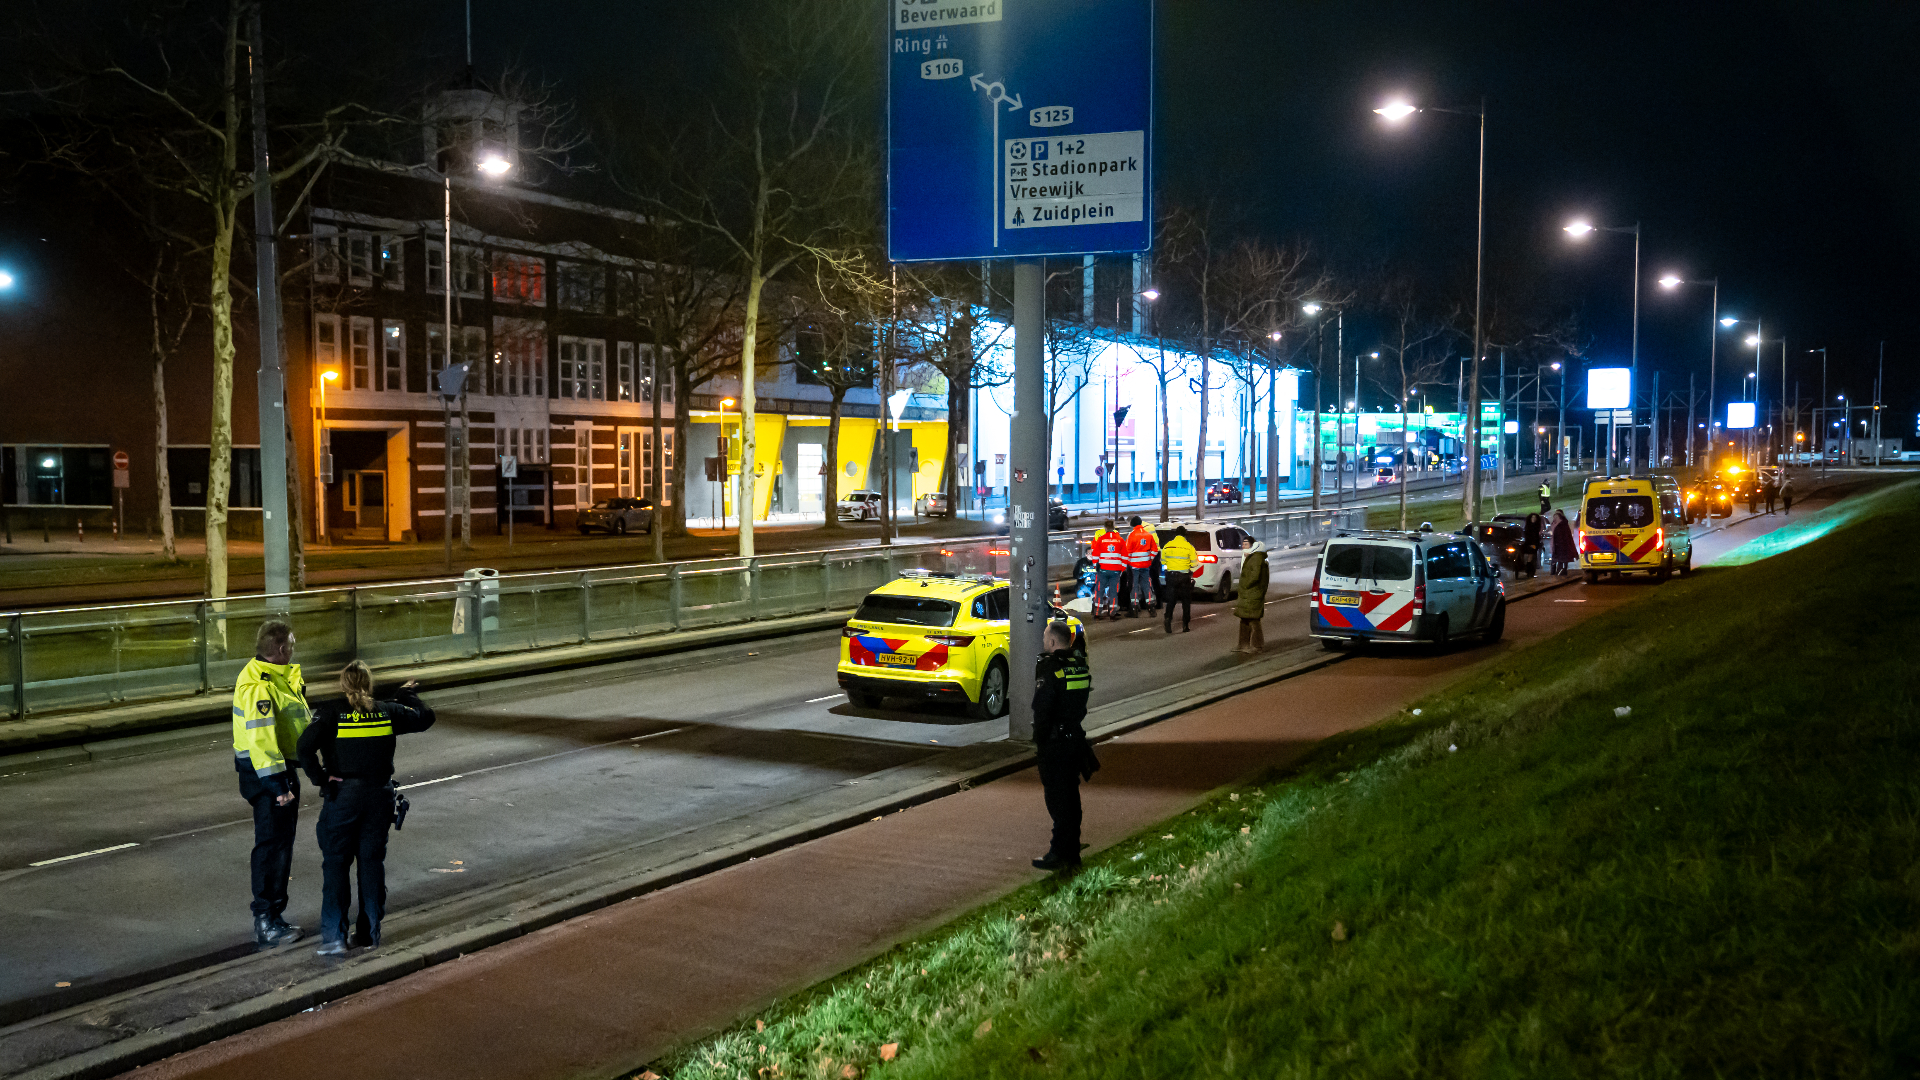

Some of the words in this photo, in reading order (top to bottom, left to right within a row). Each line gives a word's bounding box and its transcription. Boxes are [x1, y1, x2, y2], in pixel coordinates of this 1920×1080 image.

[901, 1, 996, 24] Beverwaard
[895, 37, 931, 55] Ring
[925, 64, 932, 76] S
[936, 62, 959, 75] 106
[1034, 111, 1041, 123] S
[1045, 109, 1069, 122] 125
[1056, 139, 1085, 155] 1+2
[1010, 167, 1028, 177] P+R
[1032, 156, 1137, 177] Stadionpark
[1010, 181, 1085, 200] Vreewijk
[1033, 203, 1114, 222] Zuidplein
[346, 711, 383, 722] POLITIE
